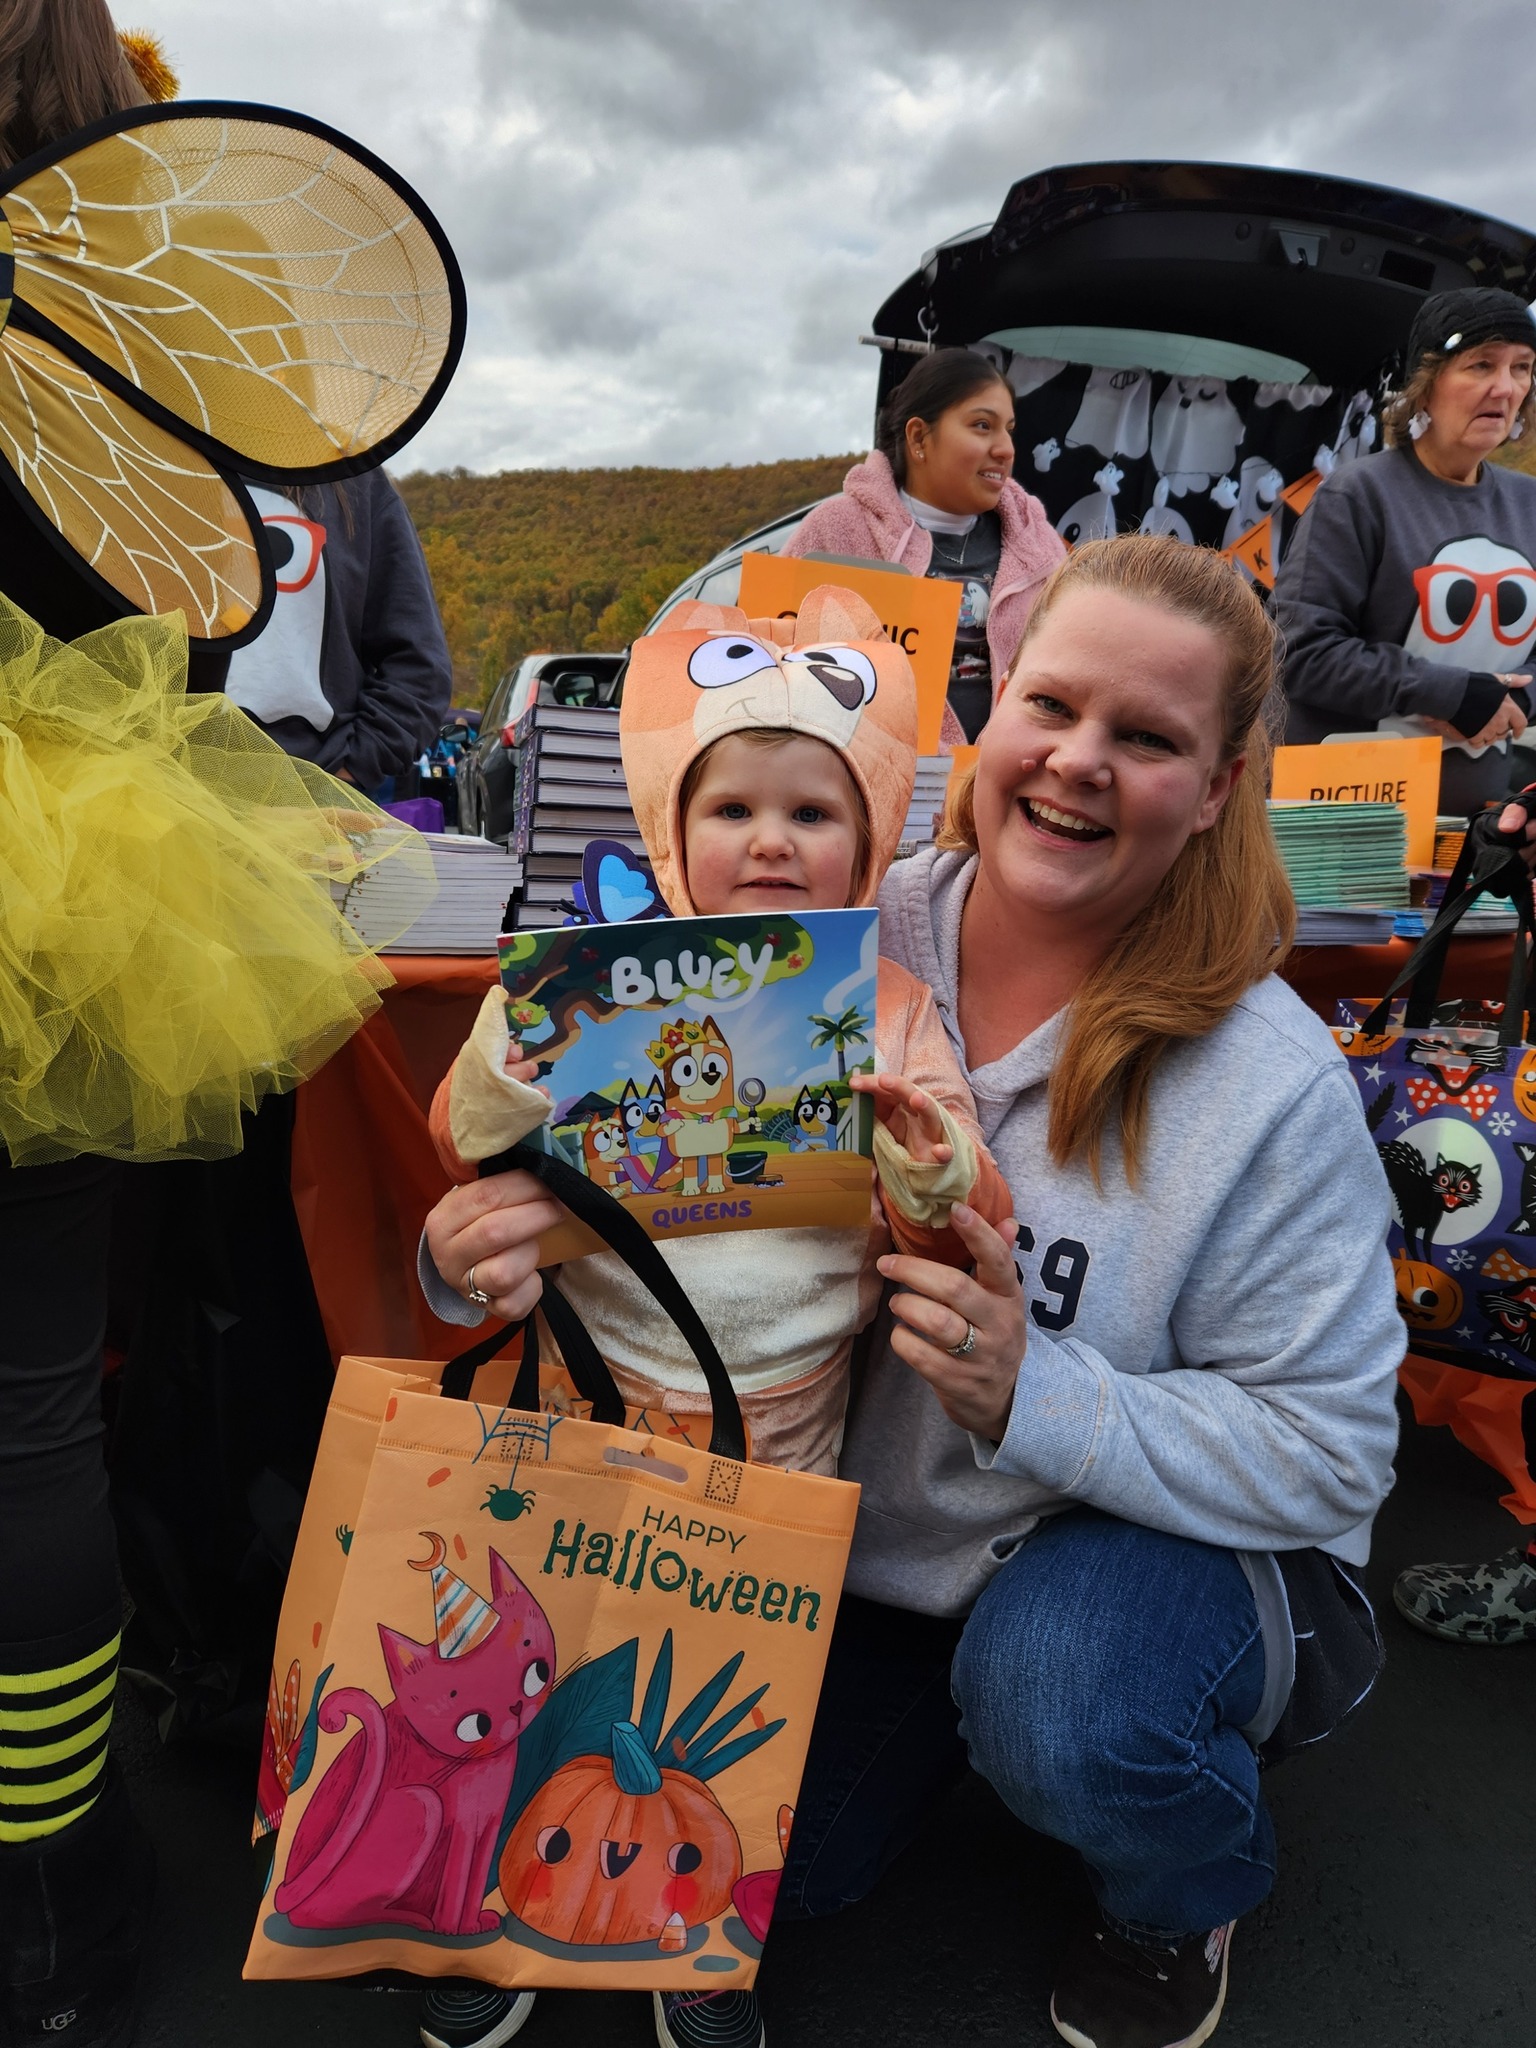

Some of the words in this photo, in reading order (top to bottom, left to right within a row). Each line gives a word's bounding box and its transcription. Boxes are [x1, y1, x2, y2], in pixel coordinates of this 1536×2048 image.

[611, 942, 774, 1013] BLUEY
[652, 1200, 752, 1228] QUEENS
[1015, 1224, 1091, 1332] 9
[642, 1505, 747, 1553] HAPPY
[541, 1518, 822, 1631] Halloween
[42, 2009, 77, 2031] UGG
